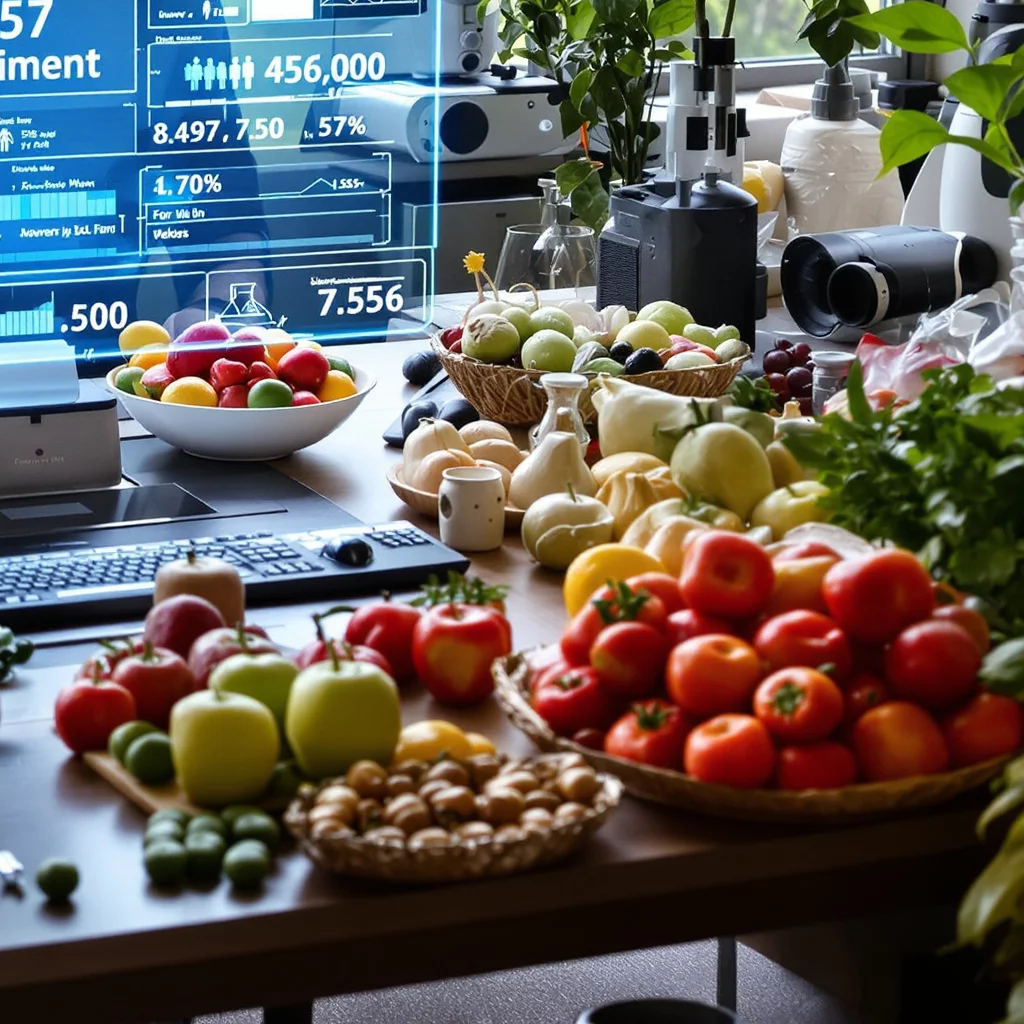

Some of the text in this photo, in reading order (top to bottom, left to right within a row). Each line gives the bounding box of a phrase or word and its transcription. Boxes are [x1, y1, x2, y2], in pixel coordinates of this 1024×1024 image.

[264, 52, 386, 85] 456,000
[318, 115, 367, 137] 57%
[317, 284, 404, 316] 7.556
